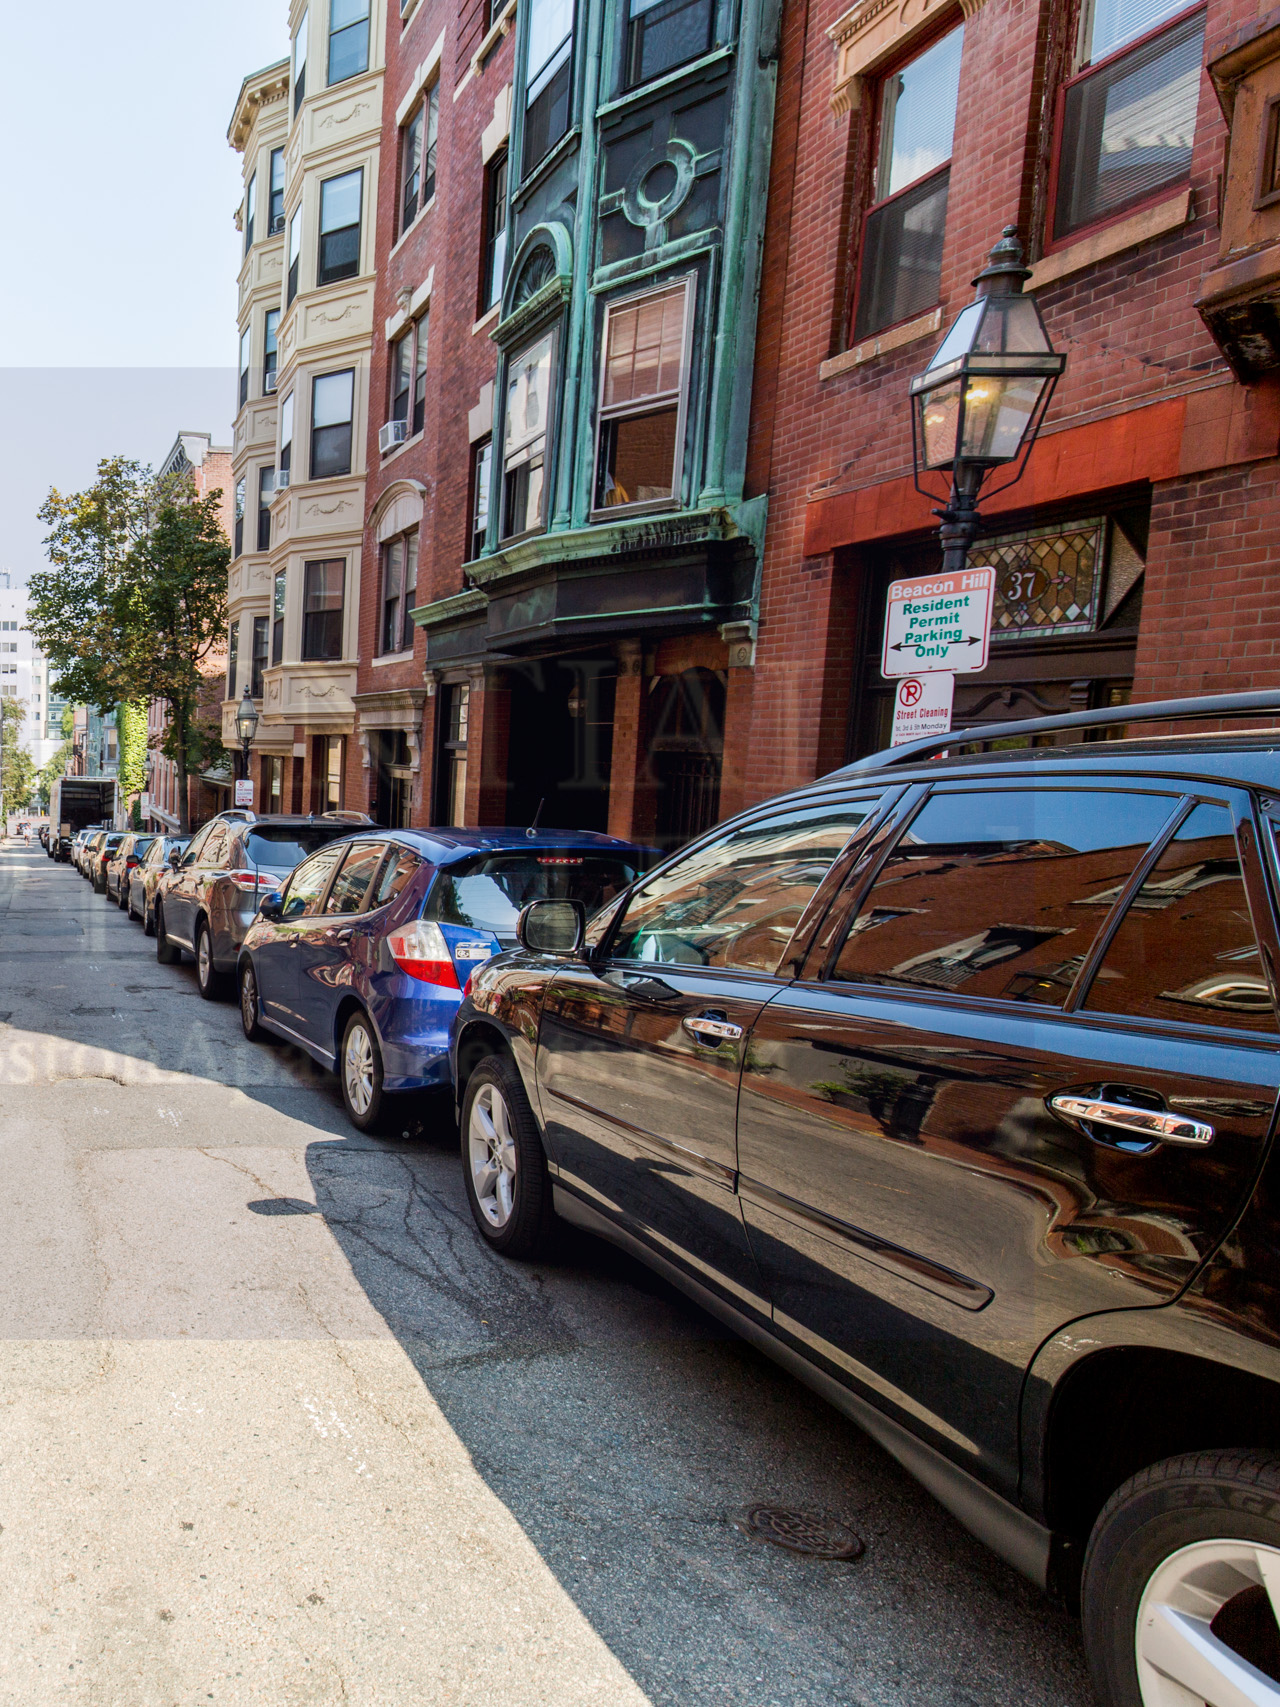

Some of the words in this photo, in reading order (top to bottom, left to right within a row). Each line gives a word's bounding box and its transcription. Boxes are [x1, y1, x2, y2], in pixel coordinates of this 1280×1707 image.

[891, 580, 954, 600] Beacon
[961, 572, 989, 590] Hill
[1008, 571, 1036, 600] 37
[902, 595, 970, 615] Resident
[909, 612, 960, 629] Permit
[904, 629, 963, 644] Parking
[915, 644, 949, 658] Only
[896, 709, 917, 720] Street
[919, 707, 949, 718] Cleaning
[920, 722, 947, 730] Monday
